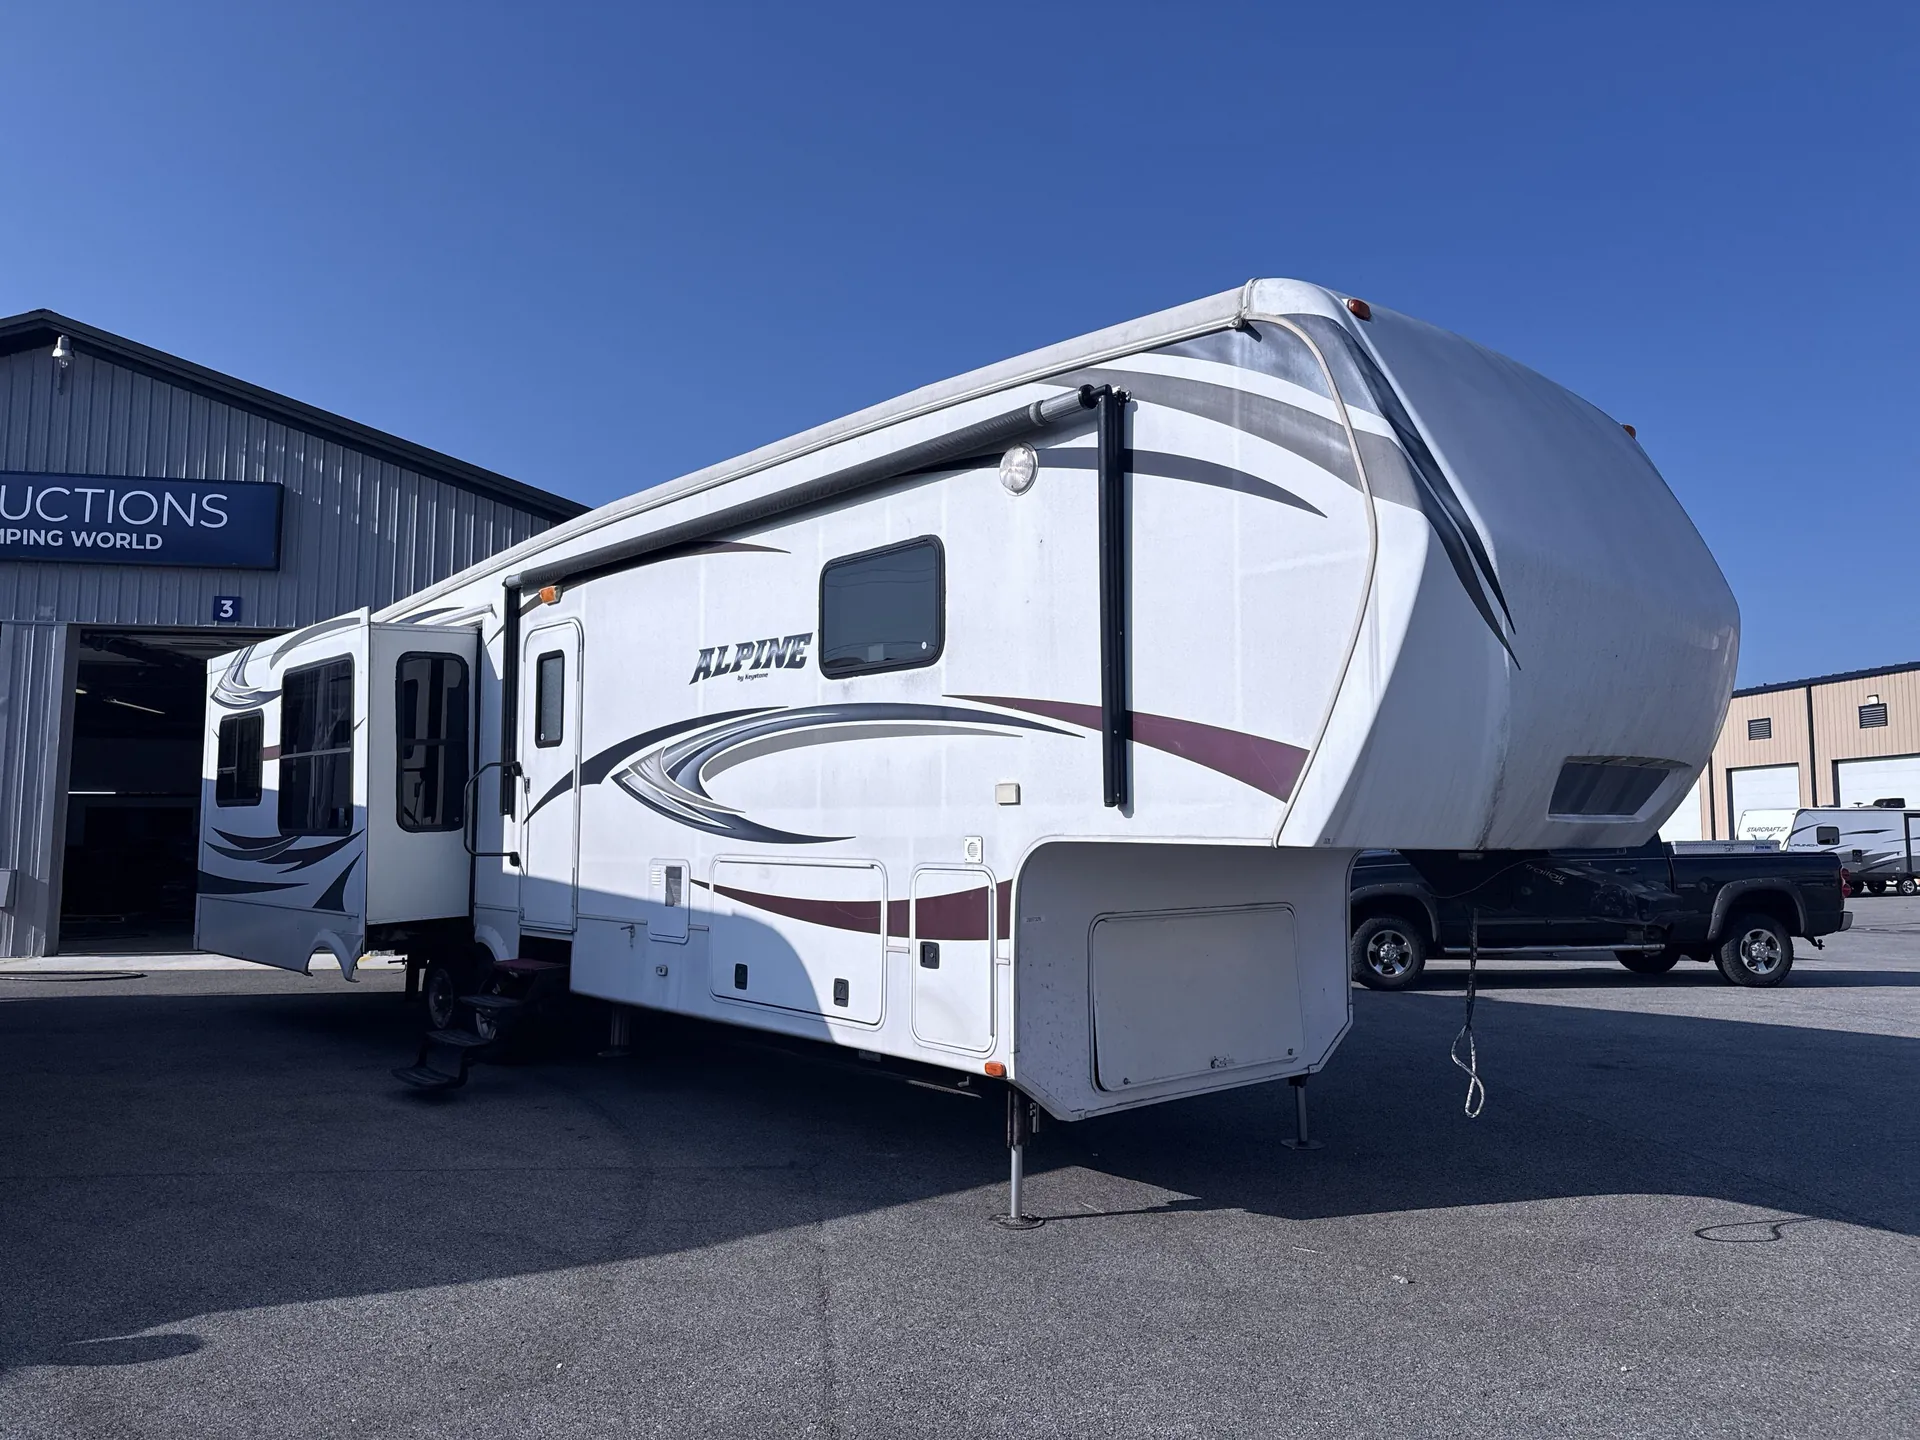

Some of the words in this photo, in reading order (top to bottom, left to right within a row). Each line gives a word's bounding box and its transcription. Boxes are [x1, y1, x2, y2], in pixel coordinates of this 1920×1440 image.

[0, 485, 228, 529] UCTIONS
[0, 528, 63, 547] PING
[71, 530, 163, 550] WORLD
[219, 600, 234, 618] 3
[689, 632, 814, 685] ALPINE
